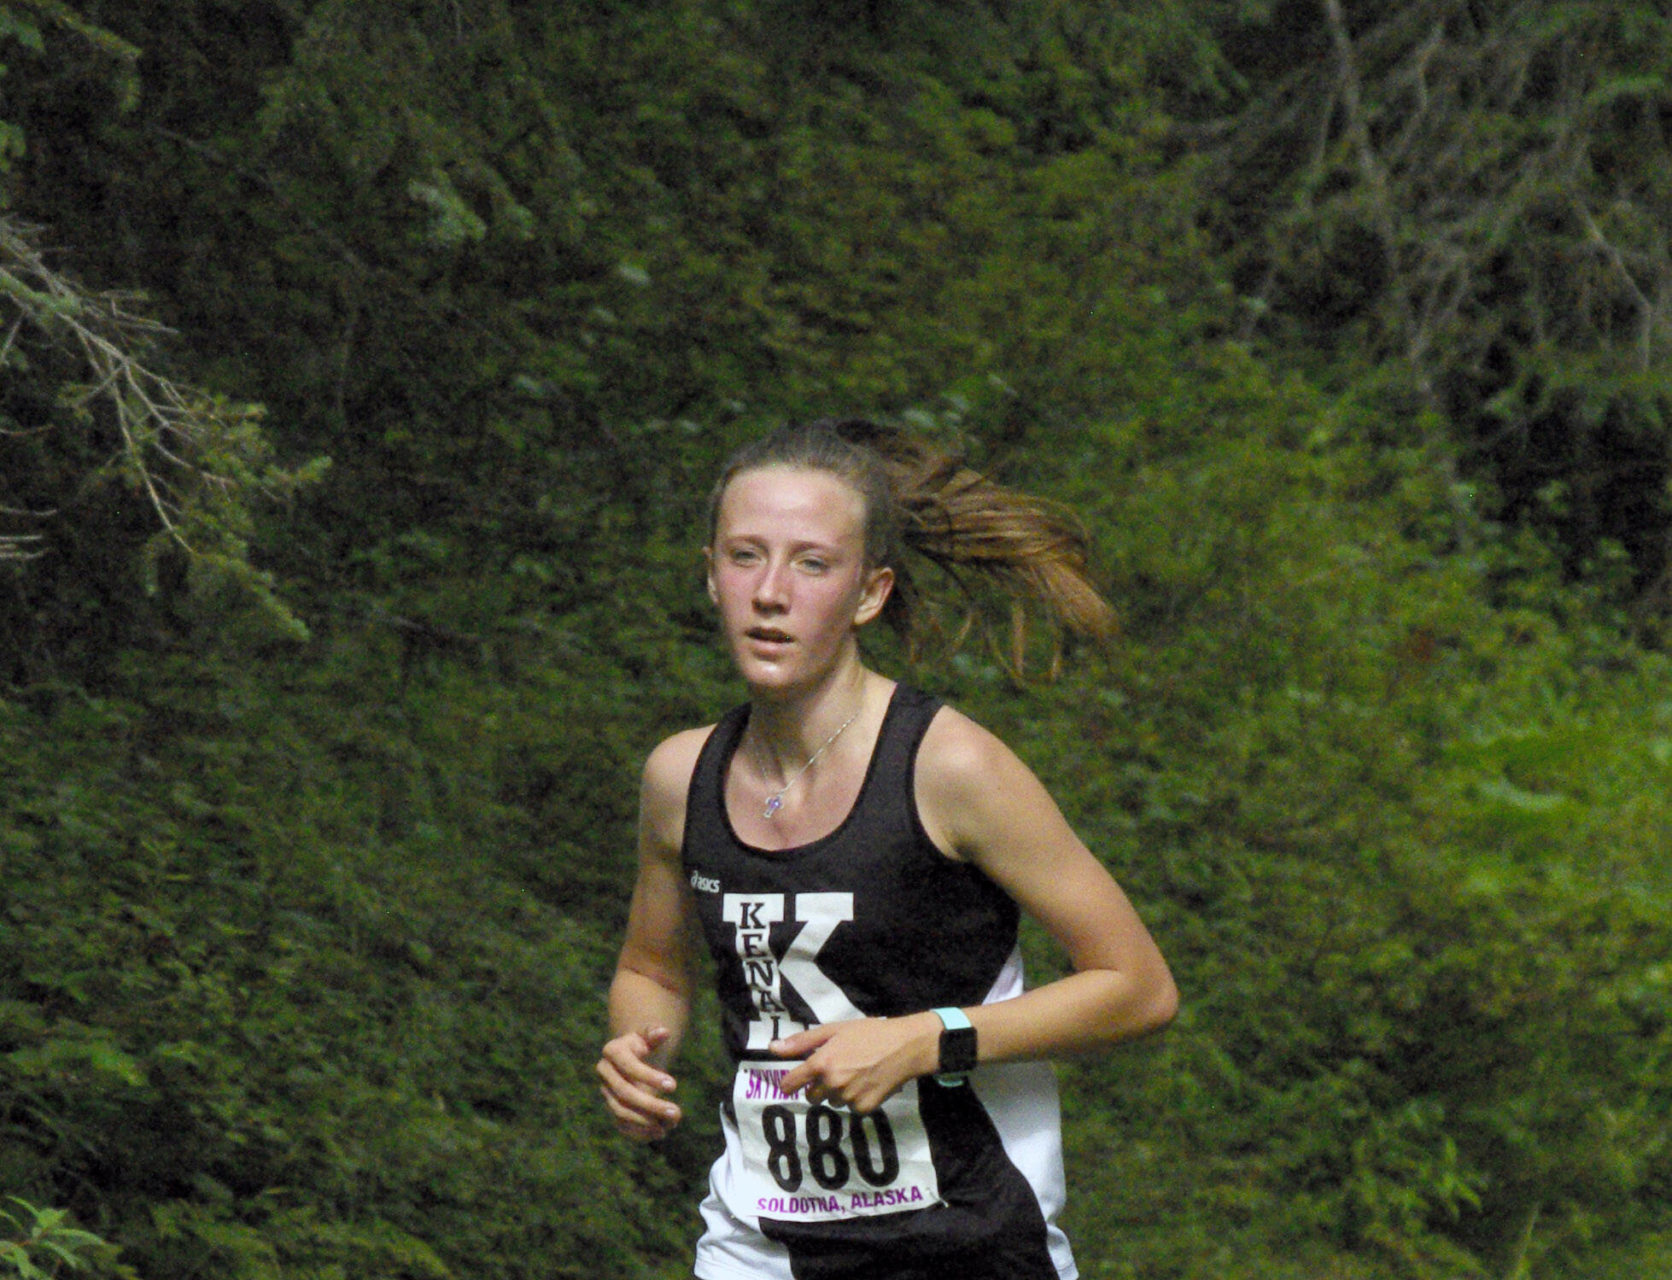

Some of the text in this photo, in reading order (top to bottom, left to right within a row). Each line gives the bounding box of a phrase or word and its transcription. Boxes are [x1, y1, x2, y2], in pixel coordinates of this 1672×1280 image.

[740, 902, 784, 1043] KENAI
[746, 1069, 799, 1099] SKYVI
[762, 1104, 899, 1193] 880
[756, 1186, 924, 1214] SOLDOTNA, ALASKA
